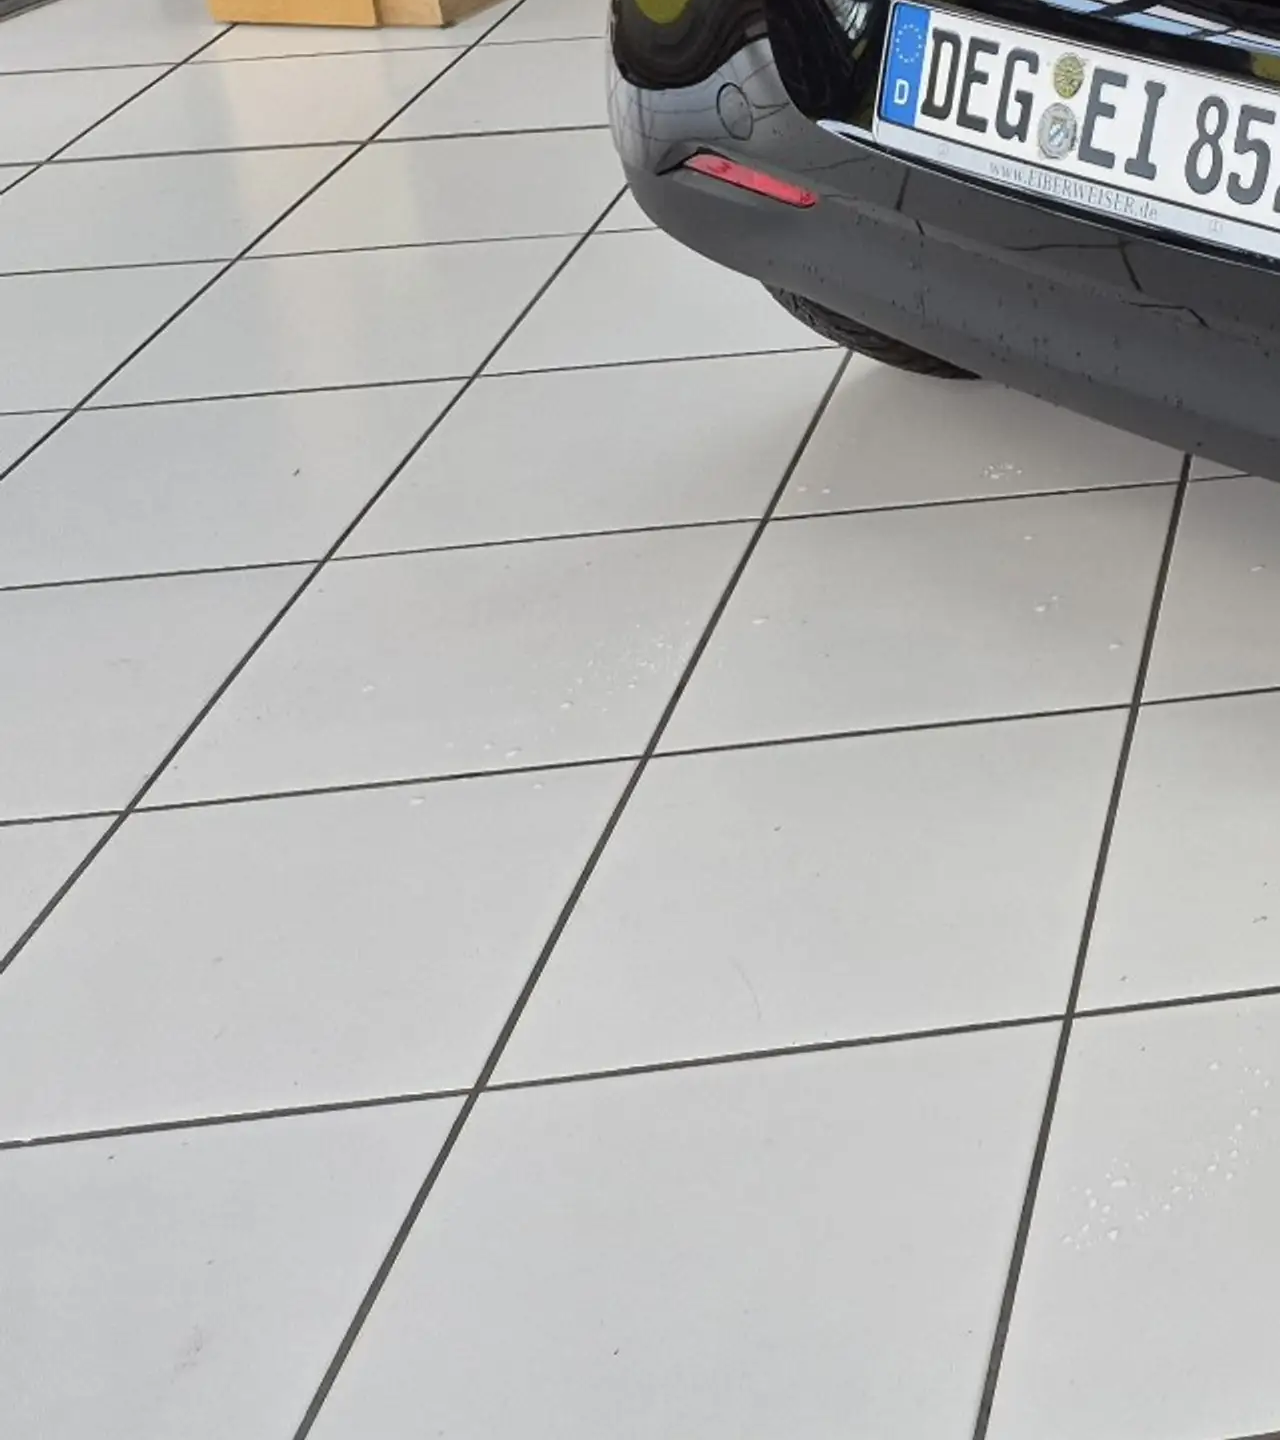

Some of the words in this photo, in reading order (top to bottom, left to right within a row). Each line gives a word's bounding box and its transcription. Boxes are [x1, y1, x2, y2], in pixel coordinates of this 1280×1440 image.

[892, 80, 910, 106] D
[921, 27, 1039, 143] DEG
[1077, 67, 1167, 181] EI
[989, 160, 1158, 221] www.EIBERWEISER.de
